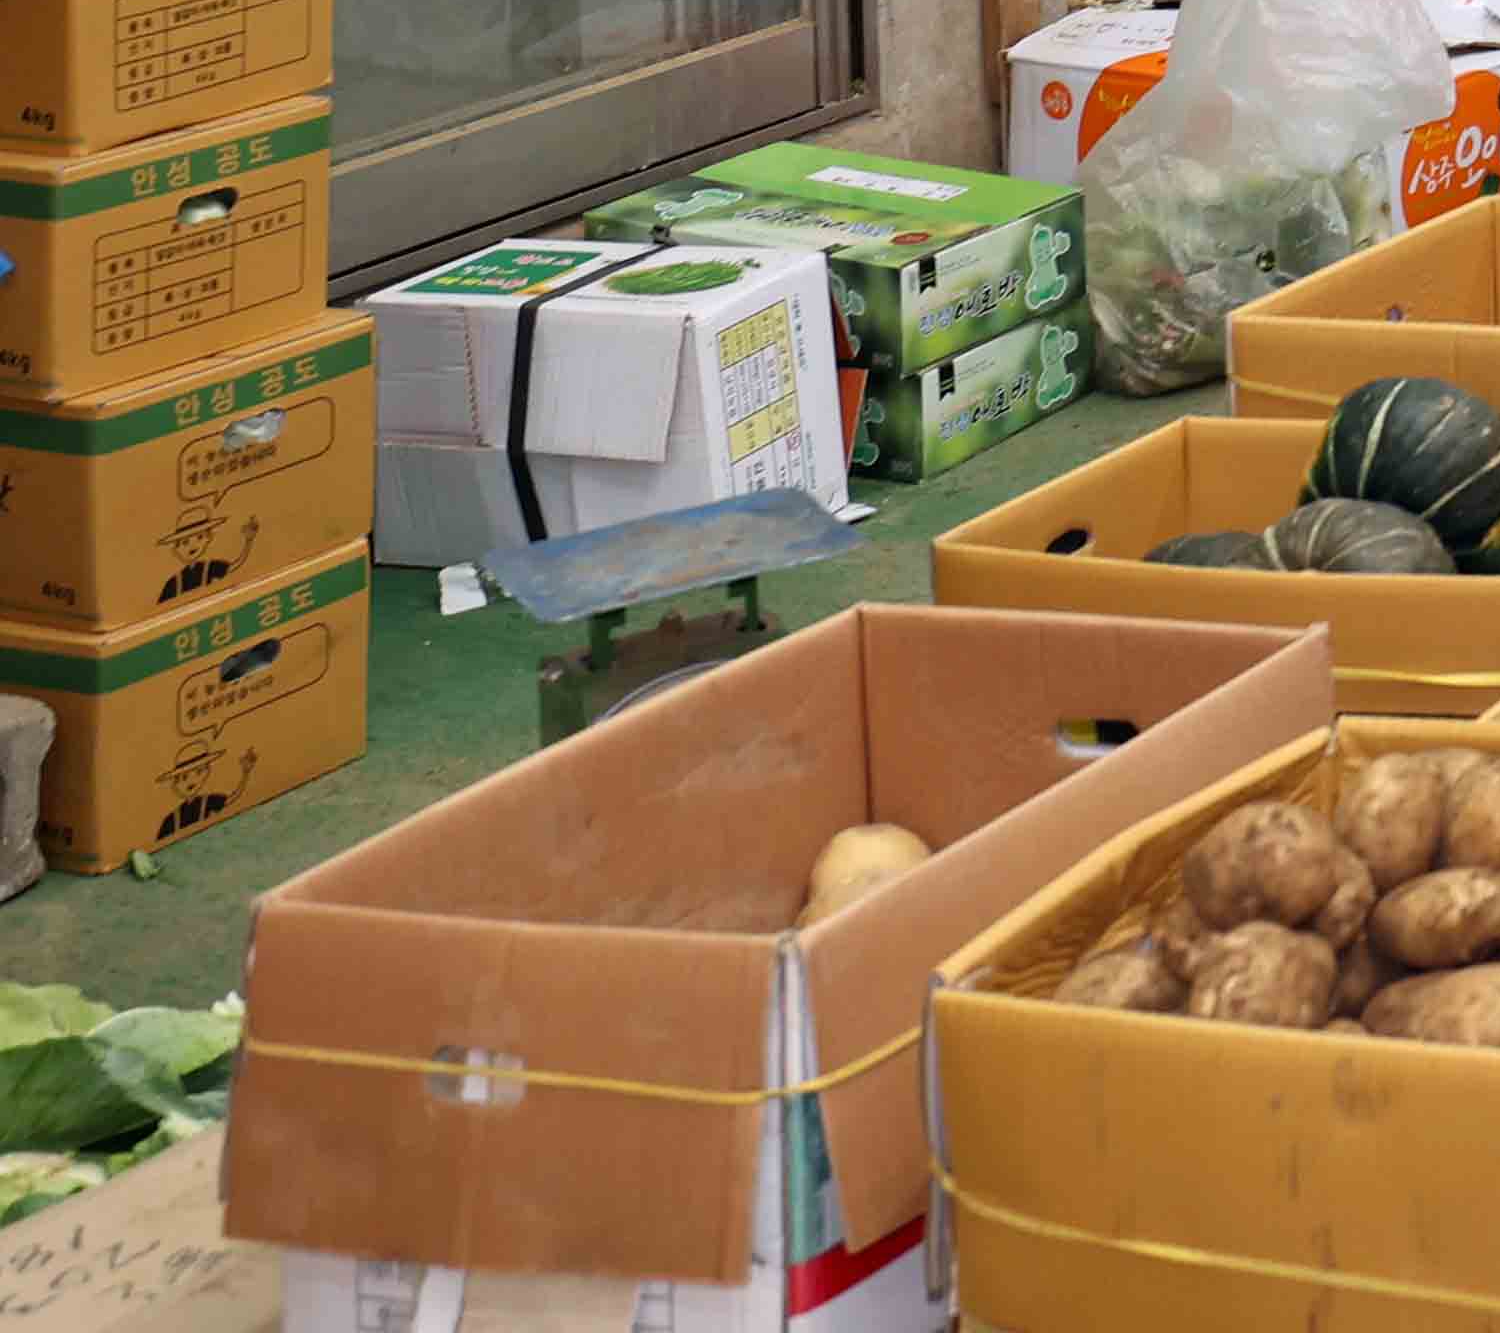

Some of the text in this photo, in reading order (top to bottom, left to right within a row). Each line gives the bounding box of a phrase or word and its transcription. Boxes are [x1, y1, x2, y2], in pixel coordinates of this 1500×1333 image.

[20, 106, 57, 132] 4kg
[131, 135, 273, 198] 안성 공도
[1408, 154, 1456, 194] 상주
[175, 354, 321, 428] 안성 공도
[174, 582, 315, 662] 안성 공도
